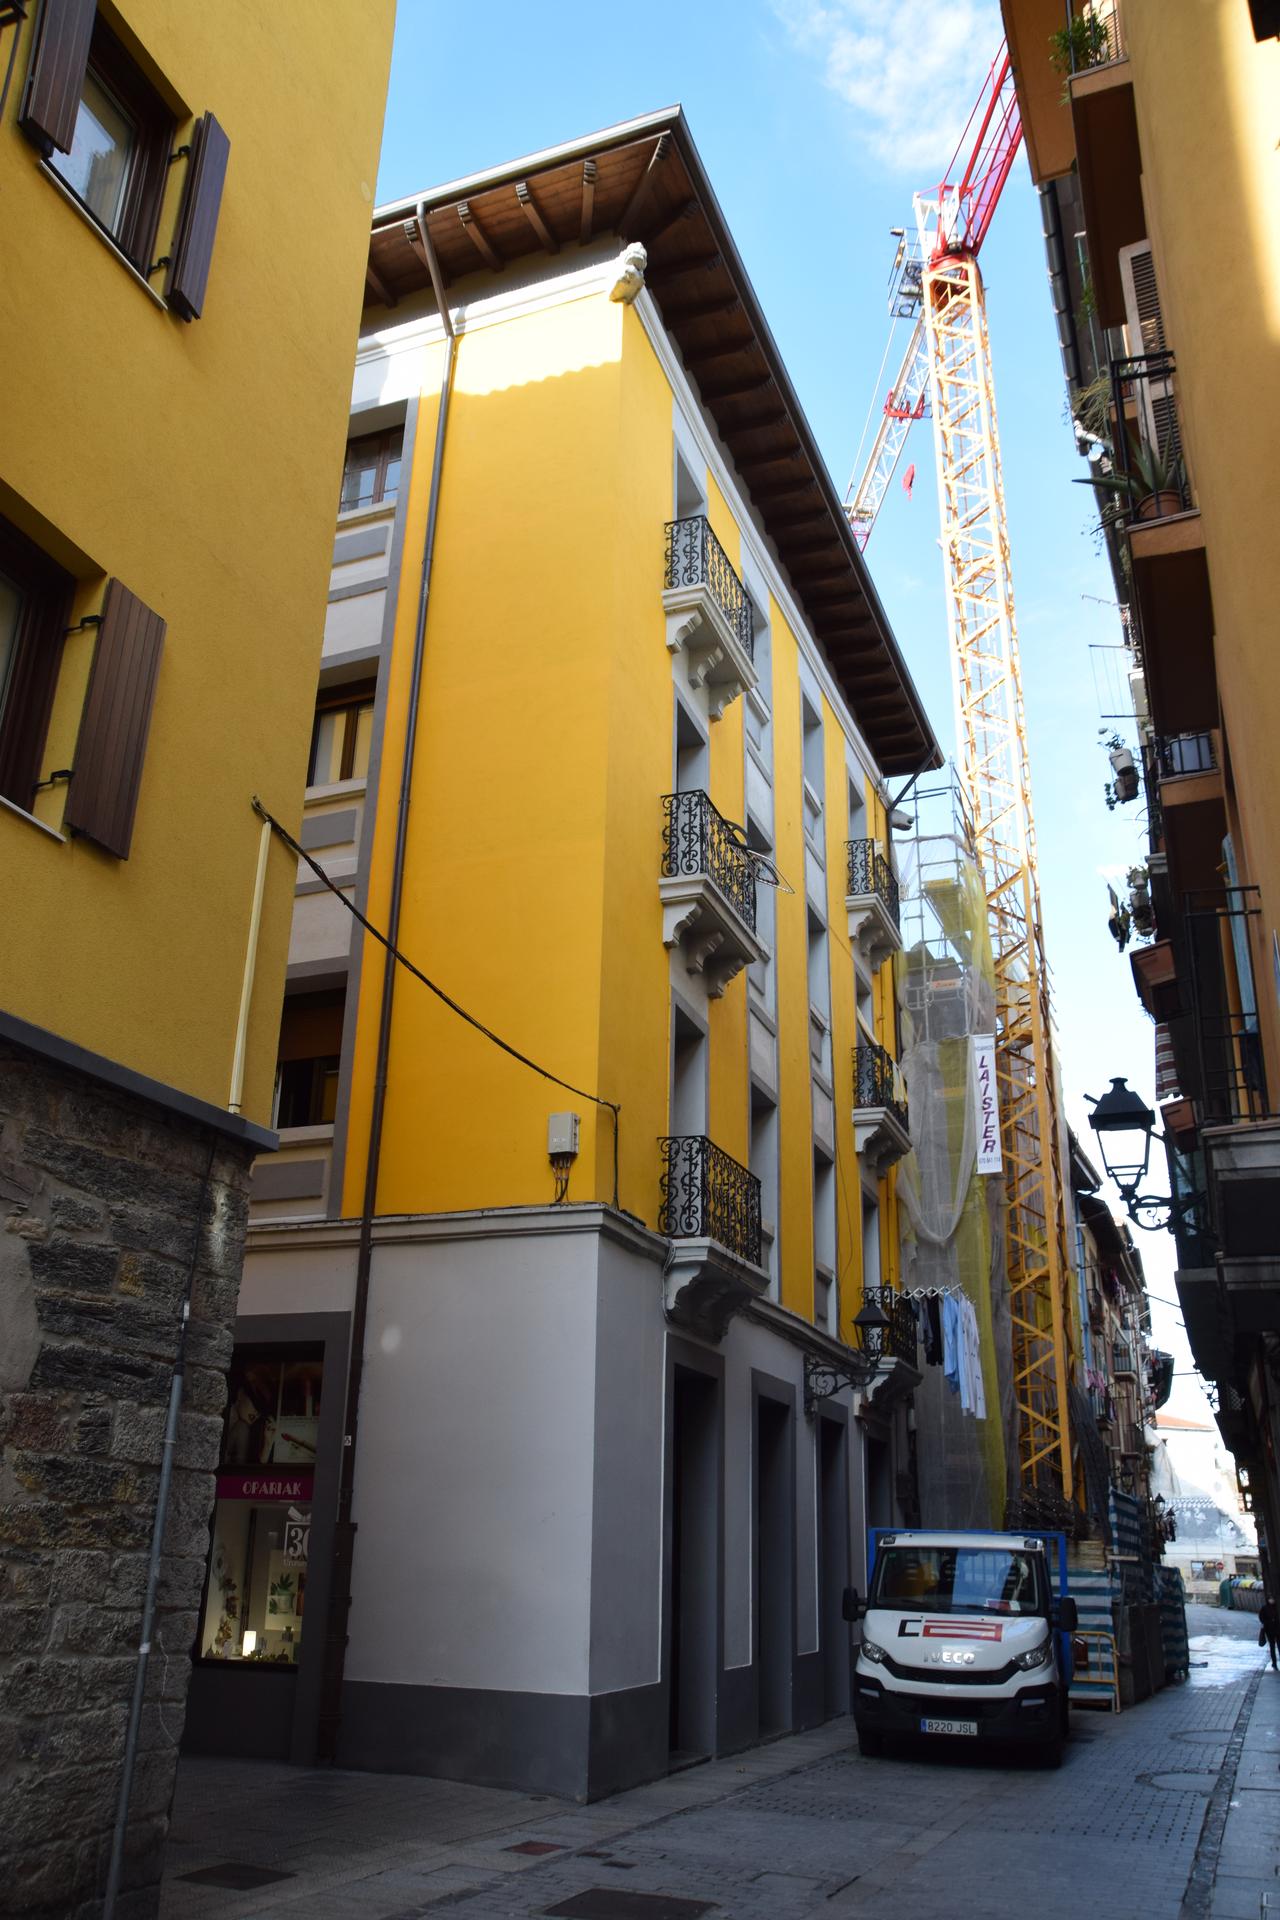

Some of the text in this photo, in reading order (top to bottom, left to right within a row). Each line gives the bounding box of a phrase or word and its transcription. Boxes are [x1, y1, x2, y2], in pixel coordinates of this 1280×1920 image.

[978, 1055, 996, 1154] LAISTER
[242, 1480, 302, 1497] OPARIAK
[923, 1650, 976, 1665] IVECO
[927, 1720, 975, 1734] 8220 JSL
